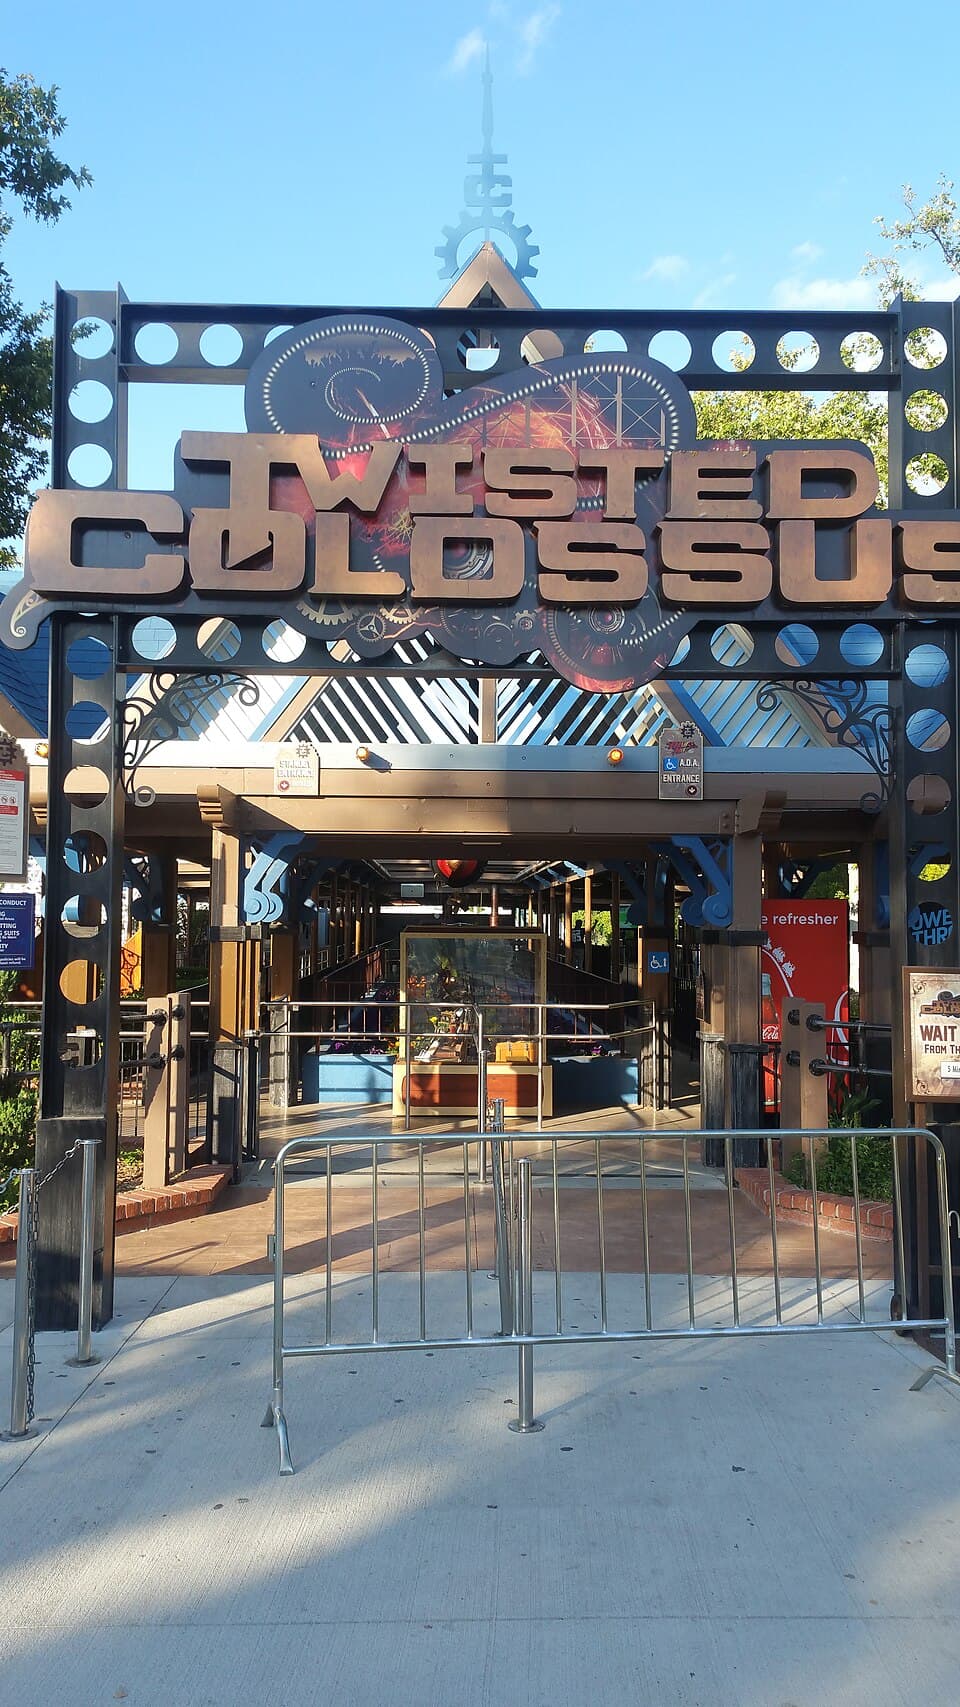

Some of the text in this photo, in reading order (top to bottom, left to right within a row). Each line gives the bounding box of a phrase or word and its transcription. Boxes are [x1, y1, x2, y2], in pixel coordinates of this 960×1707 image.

[181, 430, 880, 568] TWISTED
[662, 774, 700, 783] ENTRANCE
[773, 913, 839, 925] refresher
[920, 1025, 957, 1042] WAIT
[947, 1065, 960, 1073] 5 Mi
